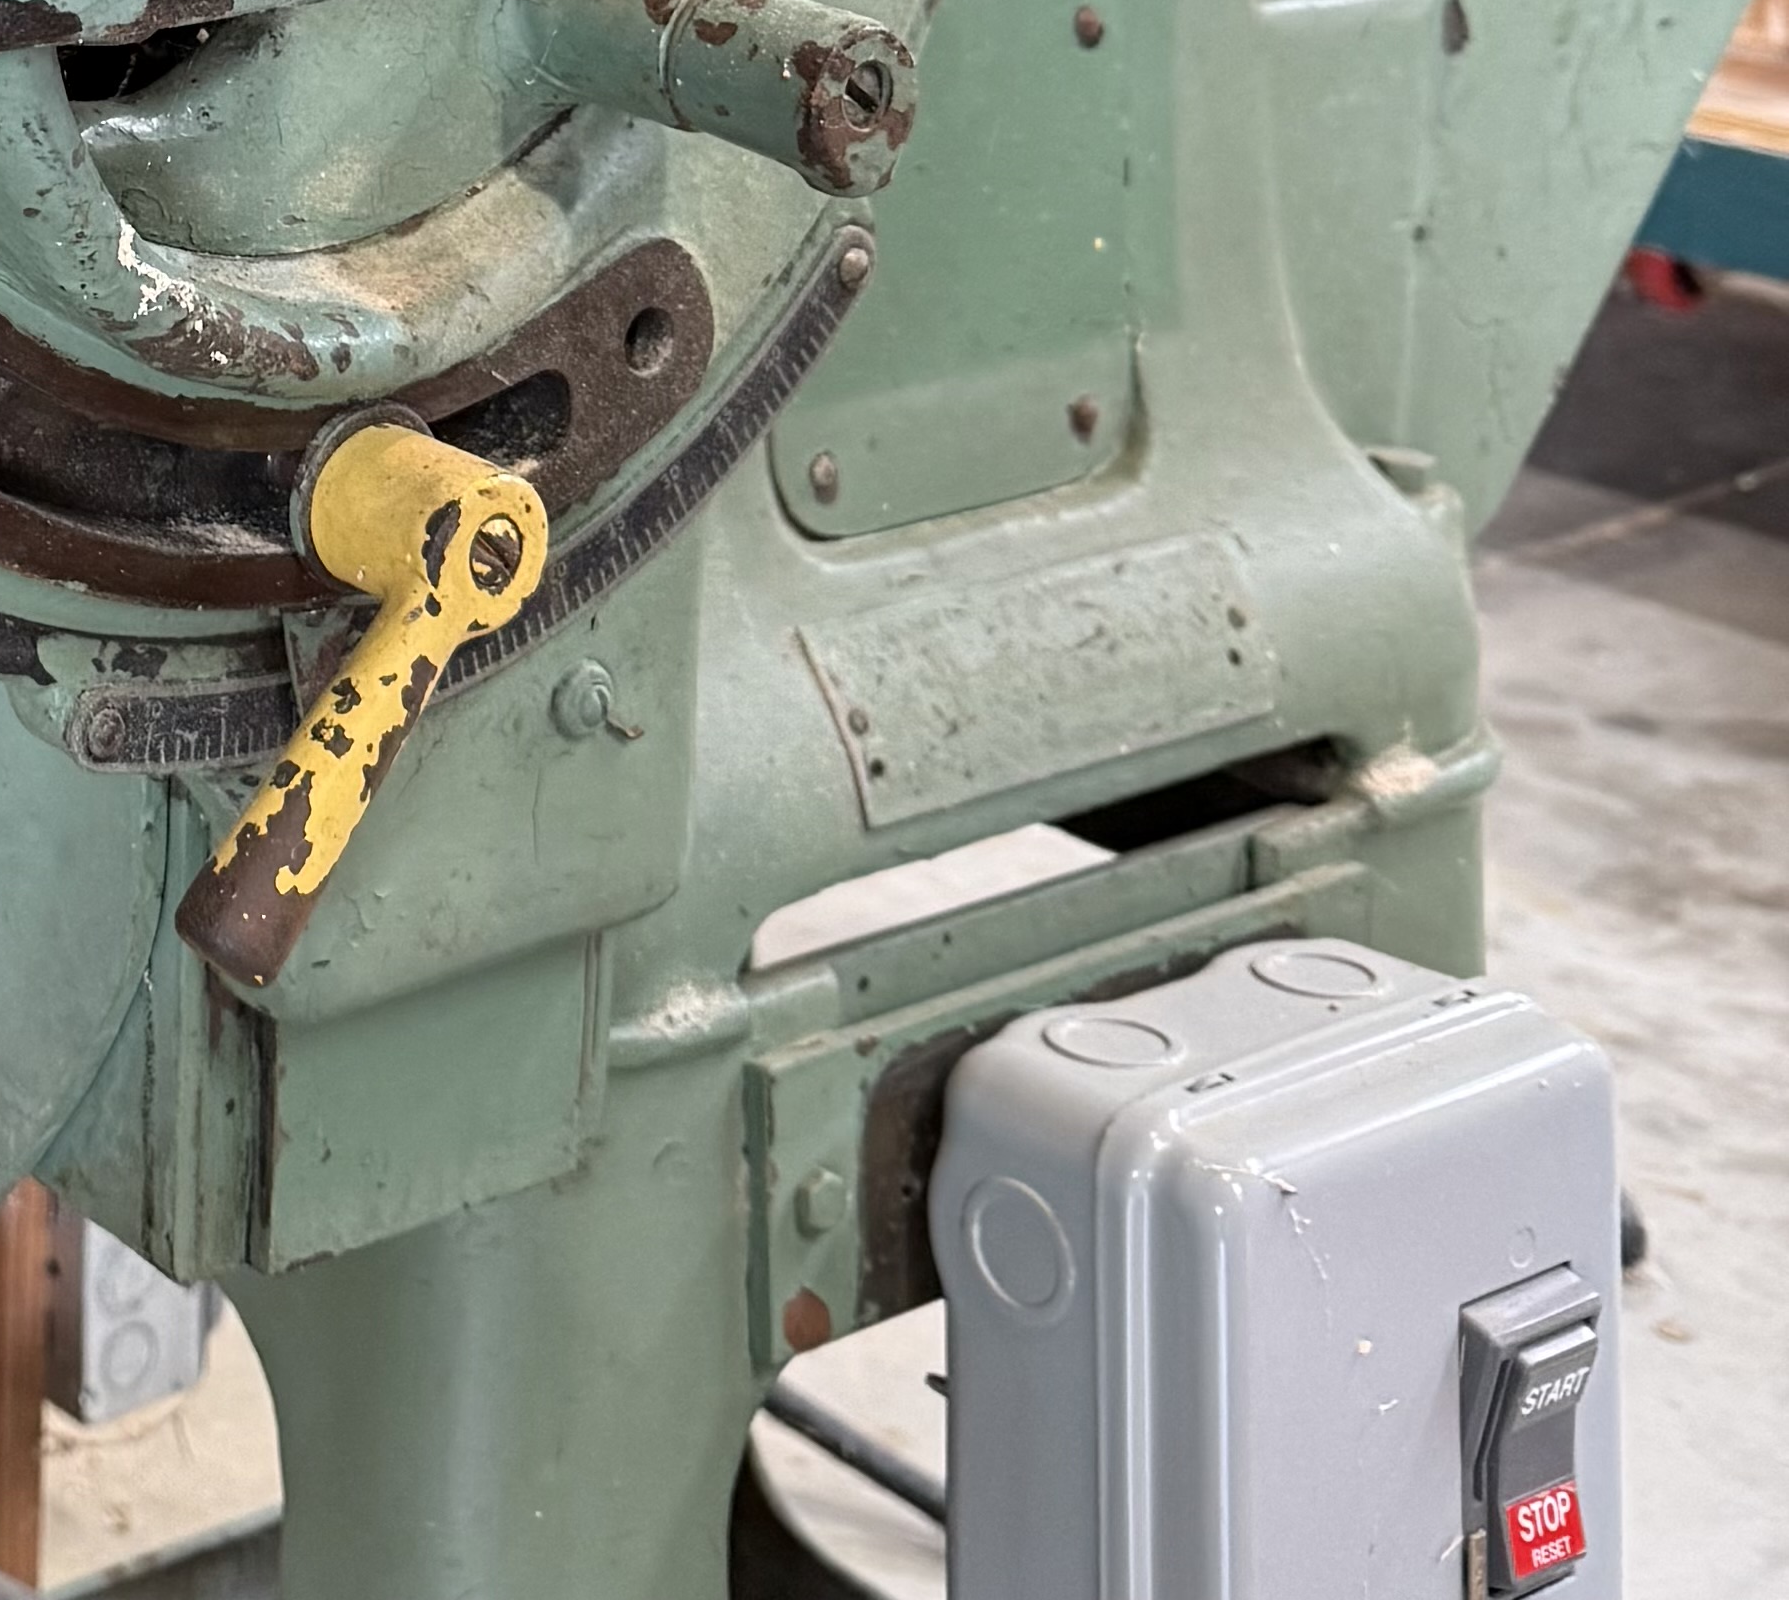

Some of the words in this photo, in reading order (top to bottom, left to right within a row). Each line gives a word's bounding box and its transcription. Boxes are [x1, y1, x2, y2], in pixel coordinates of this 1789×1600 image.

[661, 464, 681, 489] 30
[1521, 1367, 1590, 1416] START
[1517, 1491, 1571, 1543] STOP
[1531, 1535, 1572, 1569] RESET
